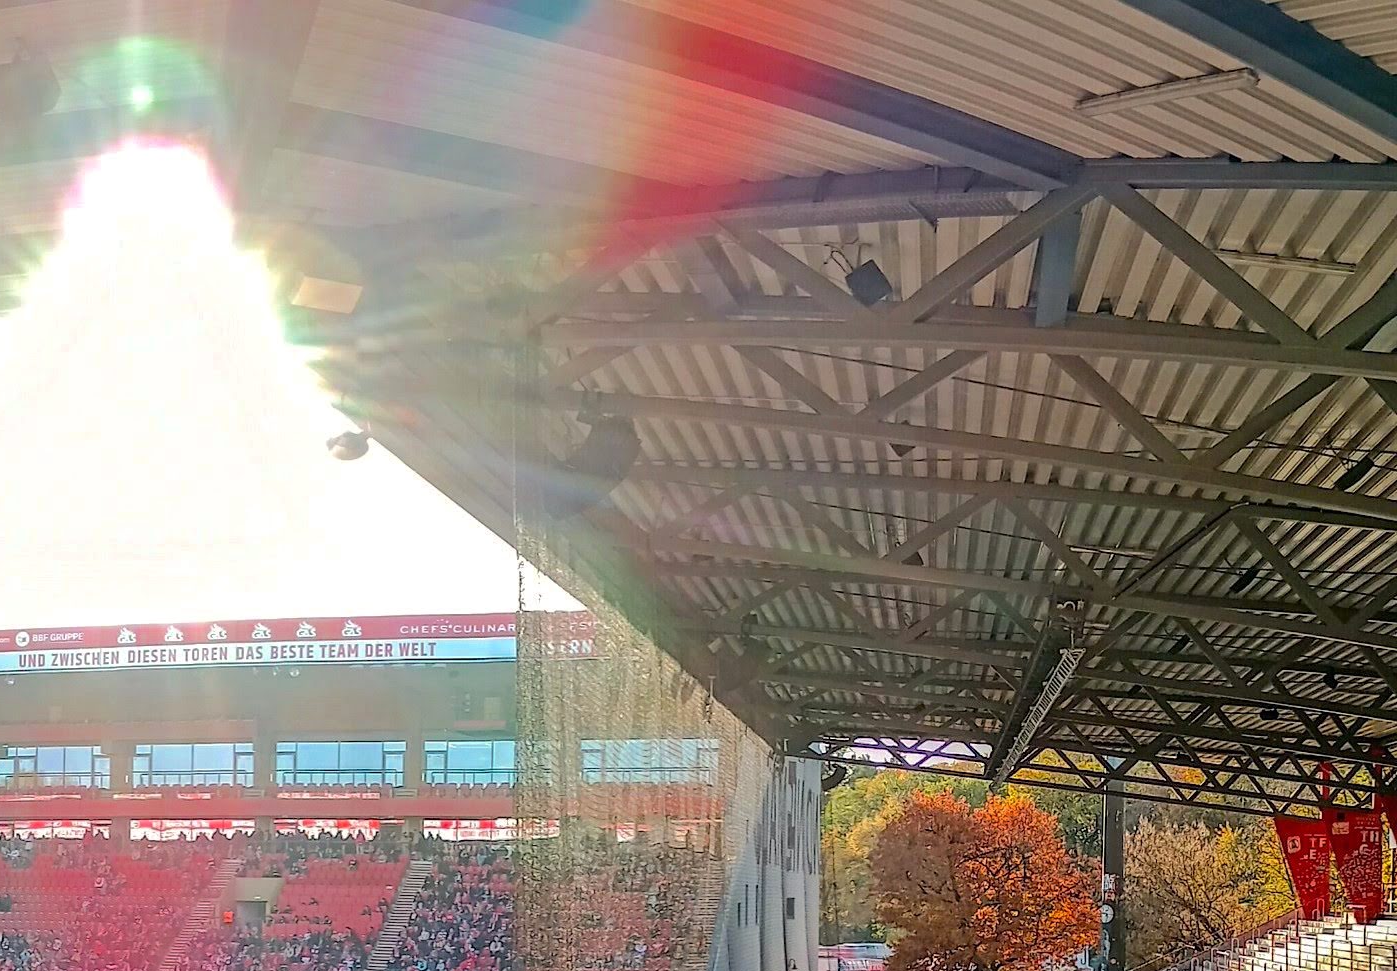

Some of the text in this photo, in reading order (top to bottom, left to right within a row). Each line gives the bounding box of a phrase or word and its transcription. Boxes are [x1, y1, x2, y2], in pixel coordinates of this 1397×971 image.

[32, 632, 84, 642] BBF GRUPPE
[19, 642, 436, 668] UND ZWISCHEN DIESEN TOREN DAS BESTE TEAM DER WELT
